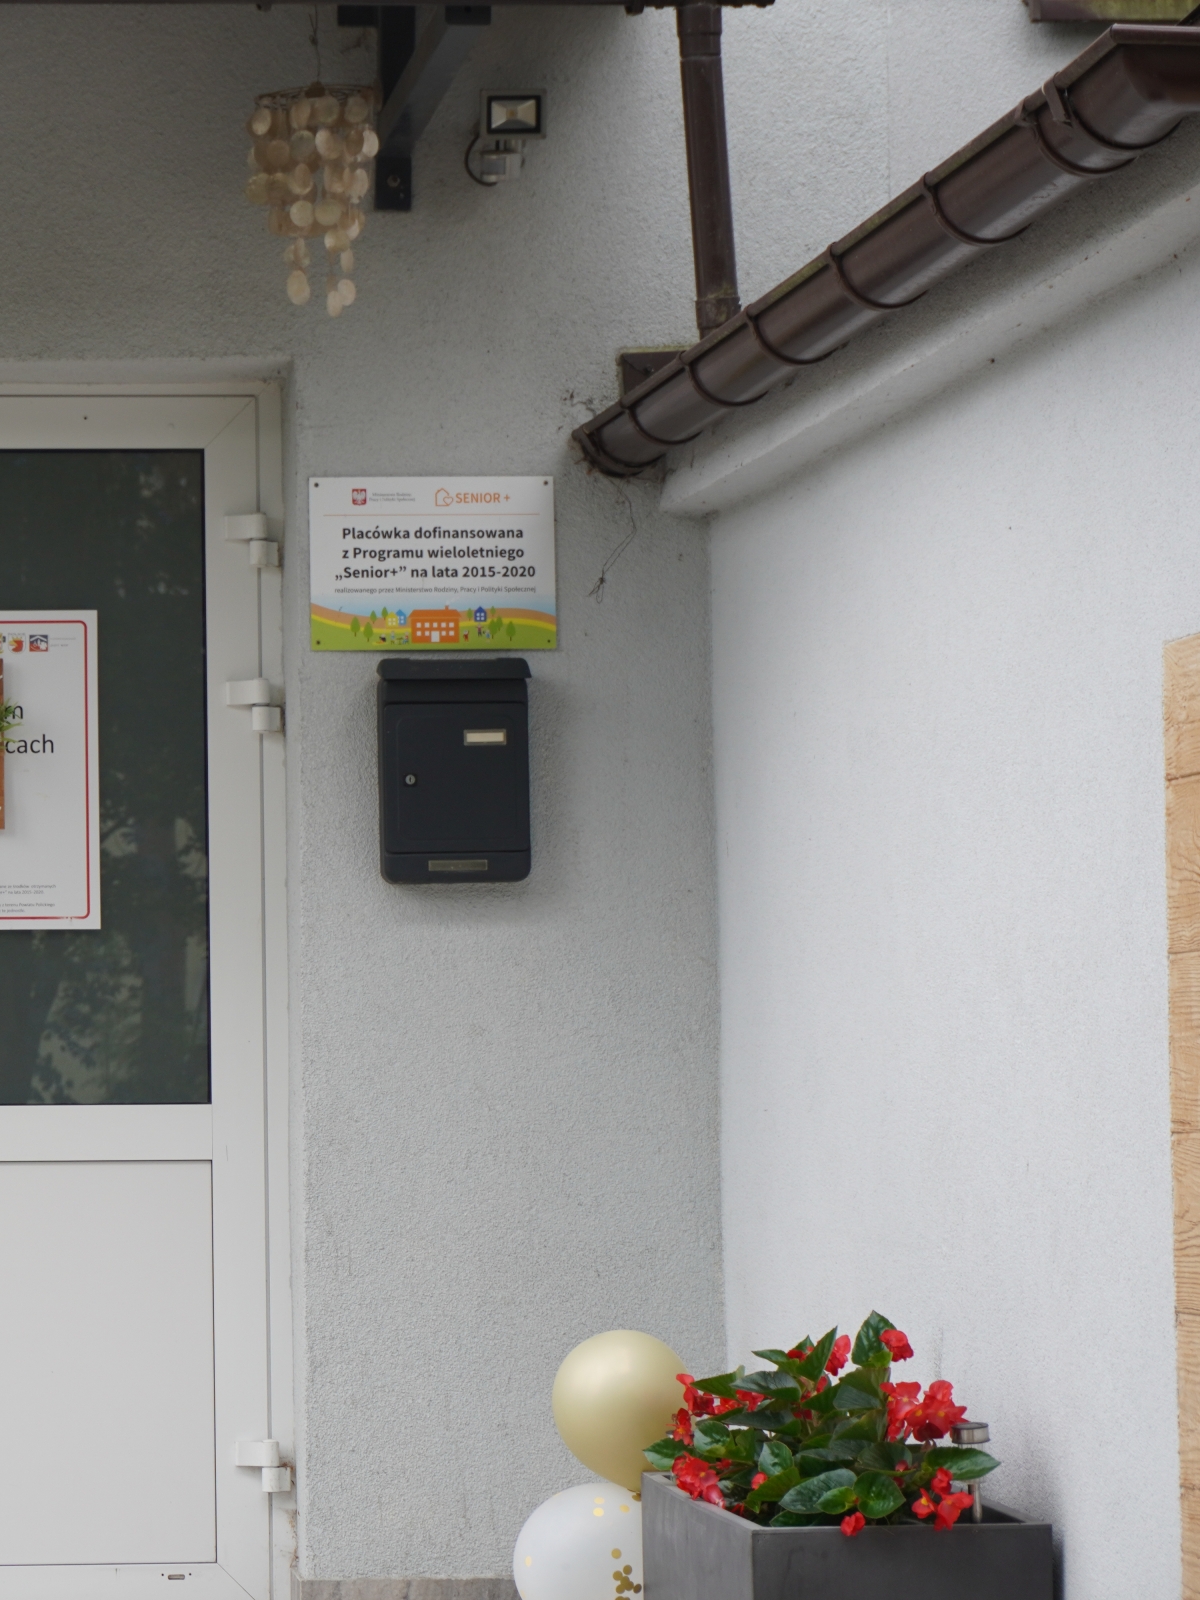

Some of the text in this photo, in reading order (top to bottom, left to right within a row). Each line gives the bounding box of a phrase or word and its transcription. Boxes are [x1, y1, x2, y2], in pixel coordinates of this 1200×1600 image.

[455, 492, 501, 504] SENIOR
[342, 525, 524, 540] Placówka dofinansowana
[342, 546, 525, 562] z Programu wieloletniego
[410, 568, 428, 578] na
[431, 566, 459, 578] lata
[462, 566, 537, 579] 2015-2020
[334, 587, 378, 595] realizowanego
[433, 587, 459, 595] Rodziny,
[460, 587, 477, 595] Pracy
[481, 587, 503, 595] Polityki
